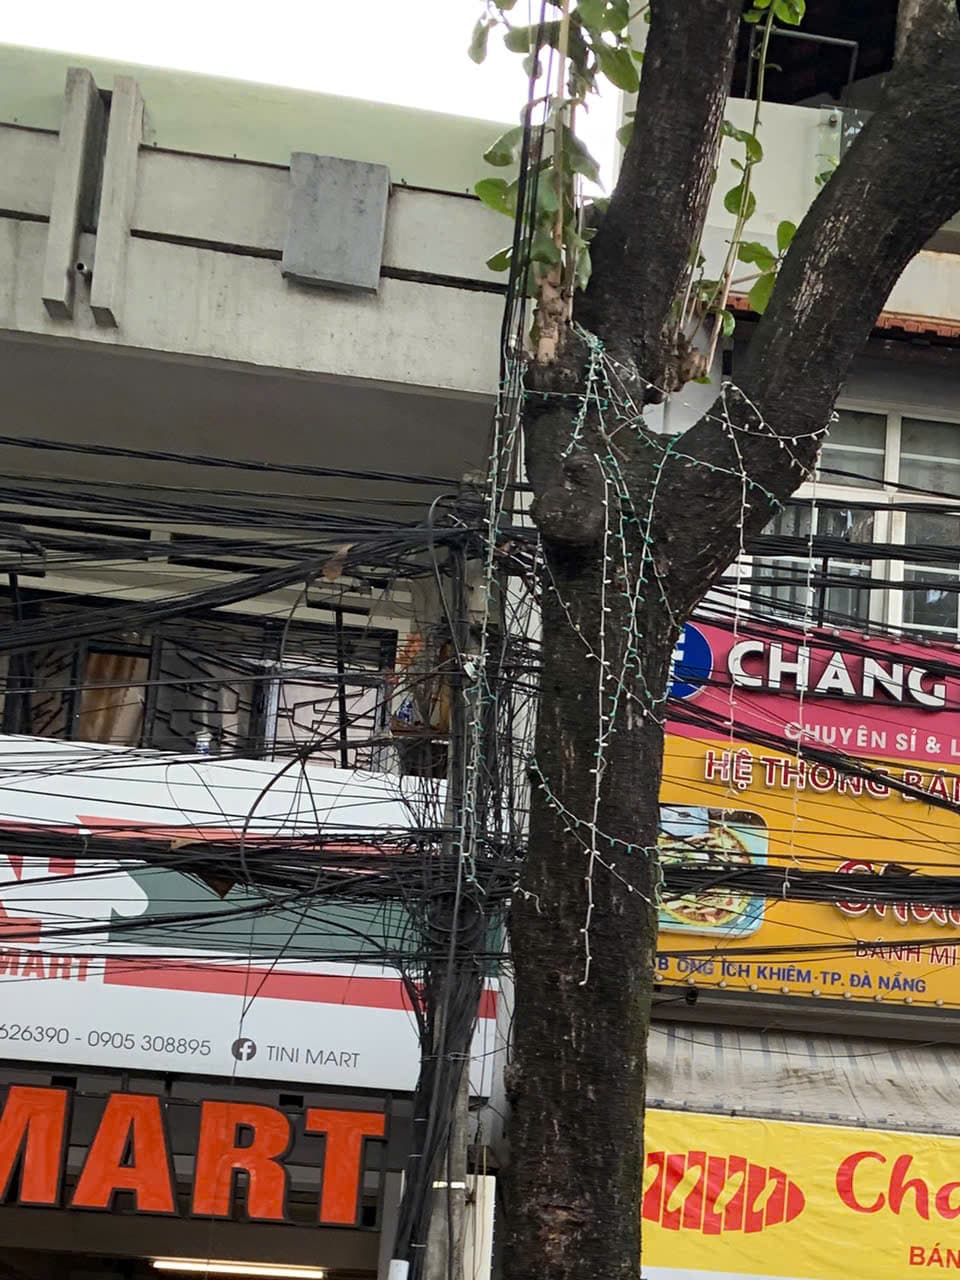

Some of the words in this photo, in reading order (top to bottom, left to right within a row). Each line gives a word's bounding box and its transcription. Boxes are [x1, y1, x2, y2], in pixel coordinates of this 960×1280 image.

[727, 640, 946, 707] CHANG
[895, 728, 917, 752] SỈ
[925, 735, 941, 754] &
[705, 747, 753, 789] HỆ
[850, 970, 872, 989] ĐÀ
[87, 1030, 135, 1050] 0905
[141, 1036, 211, 1056] 308895
[267, 1045, 299, 1063] TINI
[305, 1049, 360, 1068] MART
